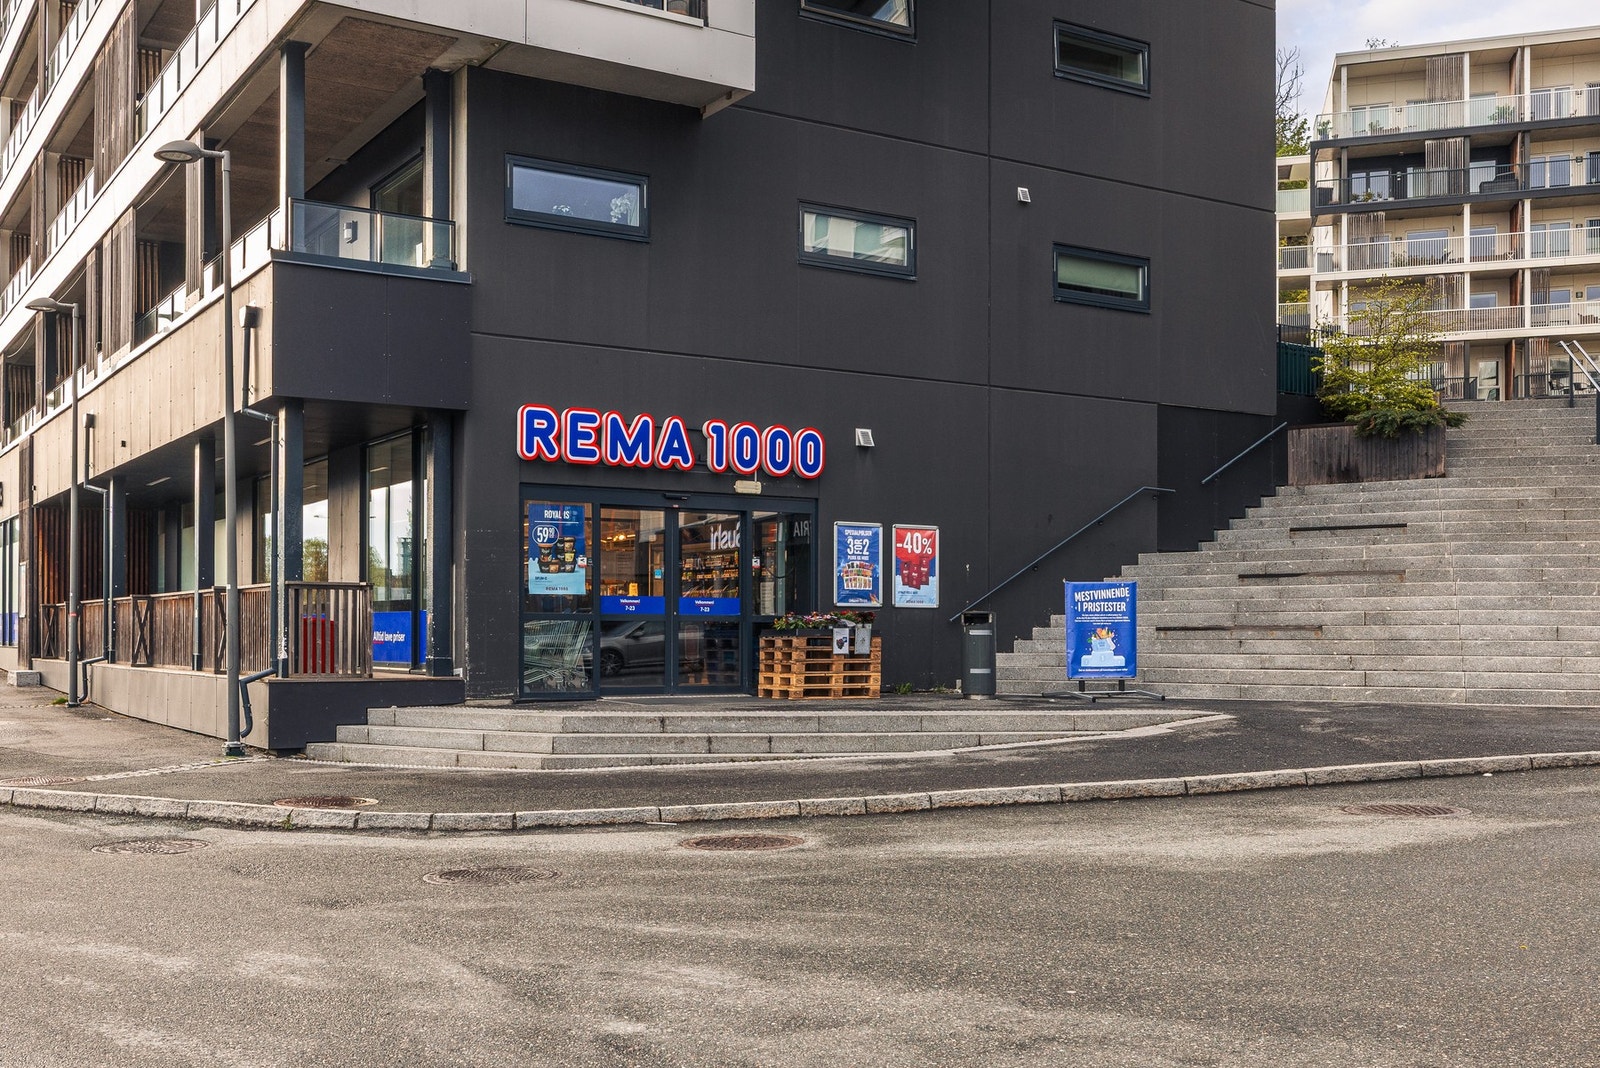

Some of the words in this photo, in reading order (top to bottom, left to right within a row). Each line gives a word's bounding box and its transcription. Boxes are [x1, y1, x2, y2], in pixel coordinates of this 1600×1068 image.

[517, 403, 695, 471] REMA
[703, 419, 825, 479] 1000
[544, 510, 562, 519] ROYAL
[563, 510, 570, 519] IS
[847, 538, 854, 555] 3
[854, 539, 863, 555] FOR
[862, 538, 870, 555] 2
[896, 532, 932, 554] -40%
[1074, 587, 1130, 602] MESTVINNENDE
[1083, 601, 1127, 612] PRISTESTER
[393, 630, 405, 643] priser
